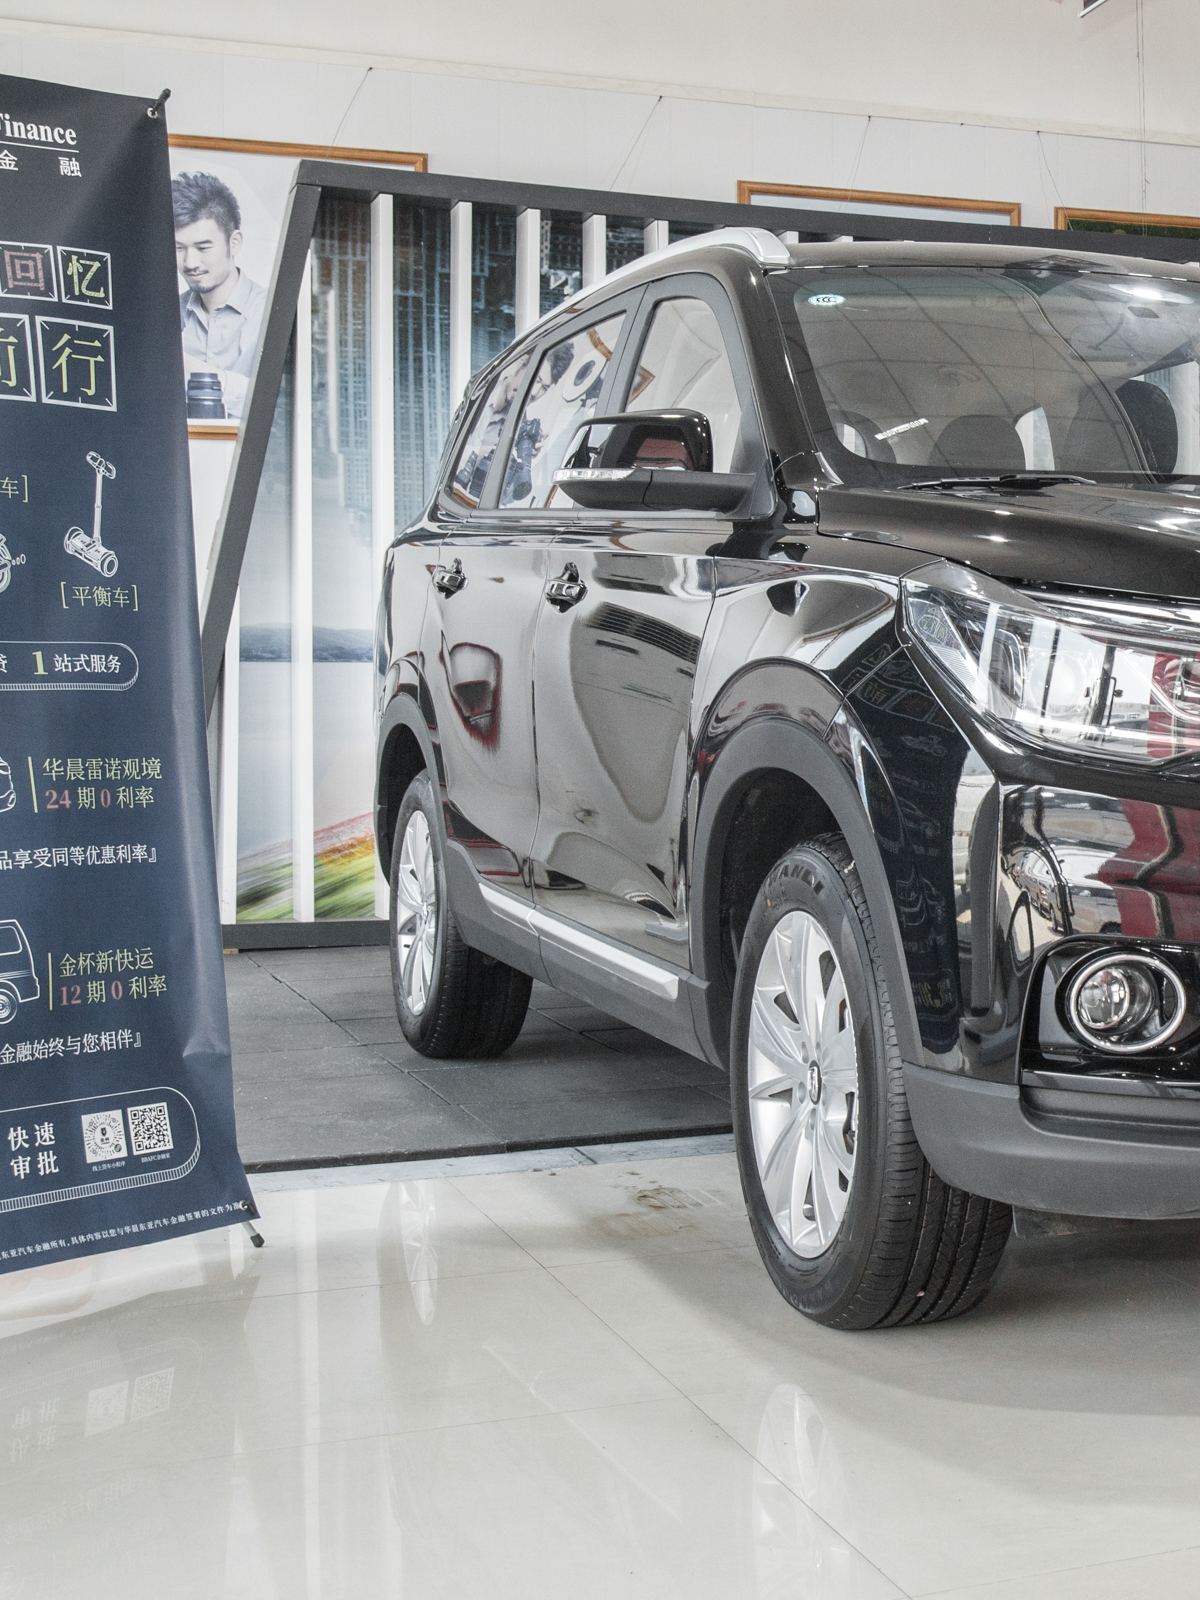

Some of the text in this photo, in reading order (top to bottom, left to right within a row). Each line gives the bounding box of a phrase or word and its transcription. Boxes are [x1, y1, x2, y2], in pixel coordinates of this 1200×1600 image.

[0, 113, 78, 145] inance
[42, 757, 163, 781] 华晨雷诺观境
[59, 946, 154, 978] 金杯新快运
[8, 1122, 56, 1151] 快速
[10, 1150, 60, 1180] 审批
